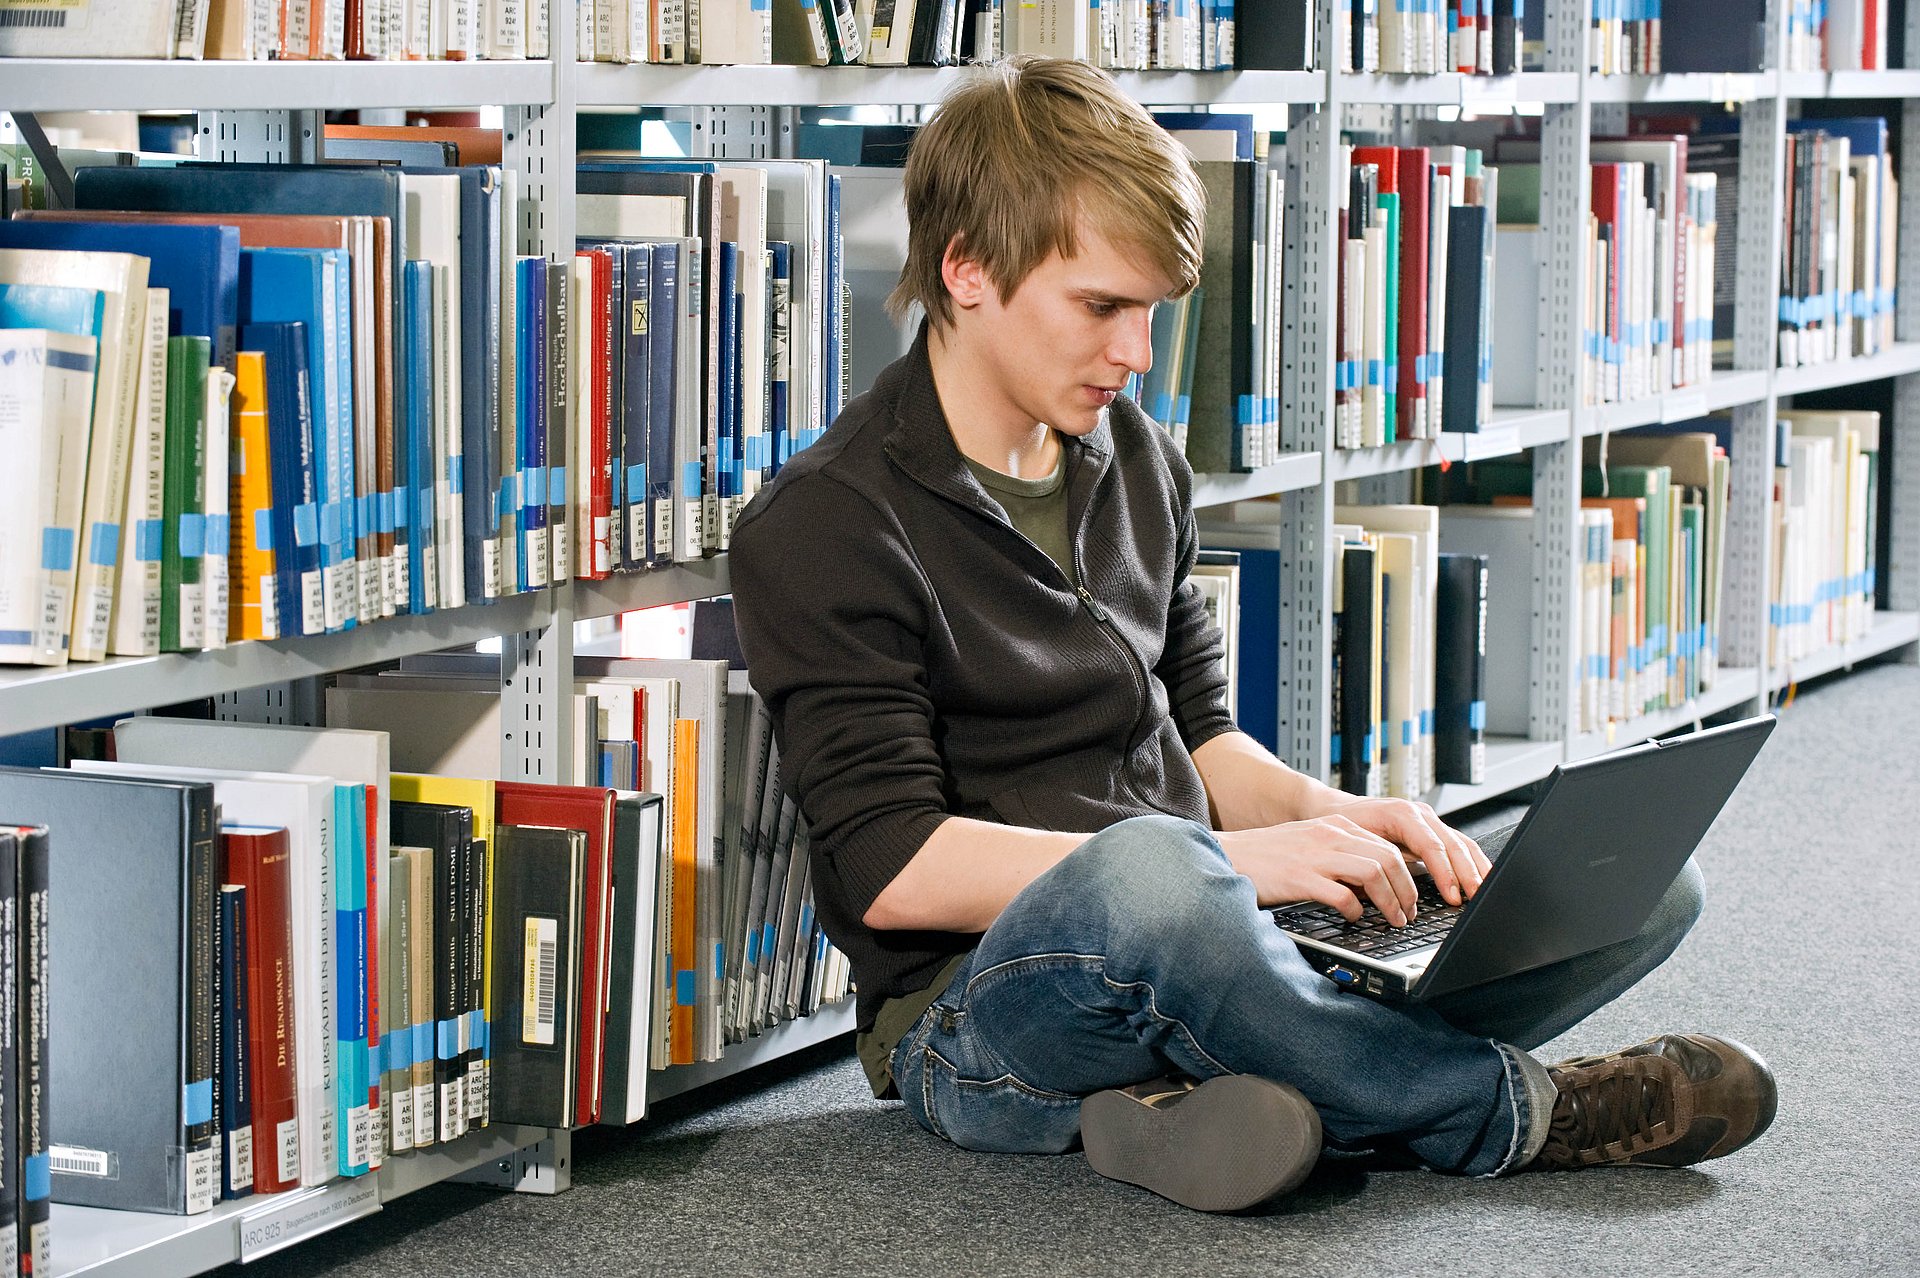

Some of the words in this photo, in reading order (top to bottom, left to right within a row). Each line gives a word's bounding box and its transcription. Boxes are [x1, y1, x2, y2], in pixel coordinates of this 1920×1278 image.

[557, 274, 568, 407] Hochschulbau
[320, 818, 328, 955] DEUTSCHLAND
[322, 961, 329, 979] IN
[321, 985, 331, 1090] KURSTÄDTE
[195, 1165, 208, 1176] ARC
[244, 1229, 263, 1249] ARC
[264, 1221, 281, 1241] 925
